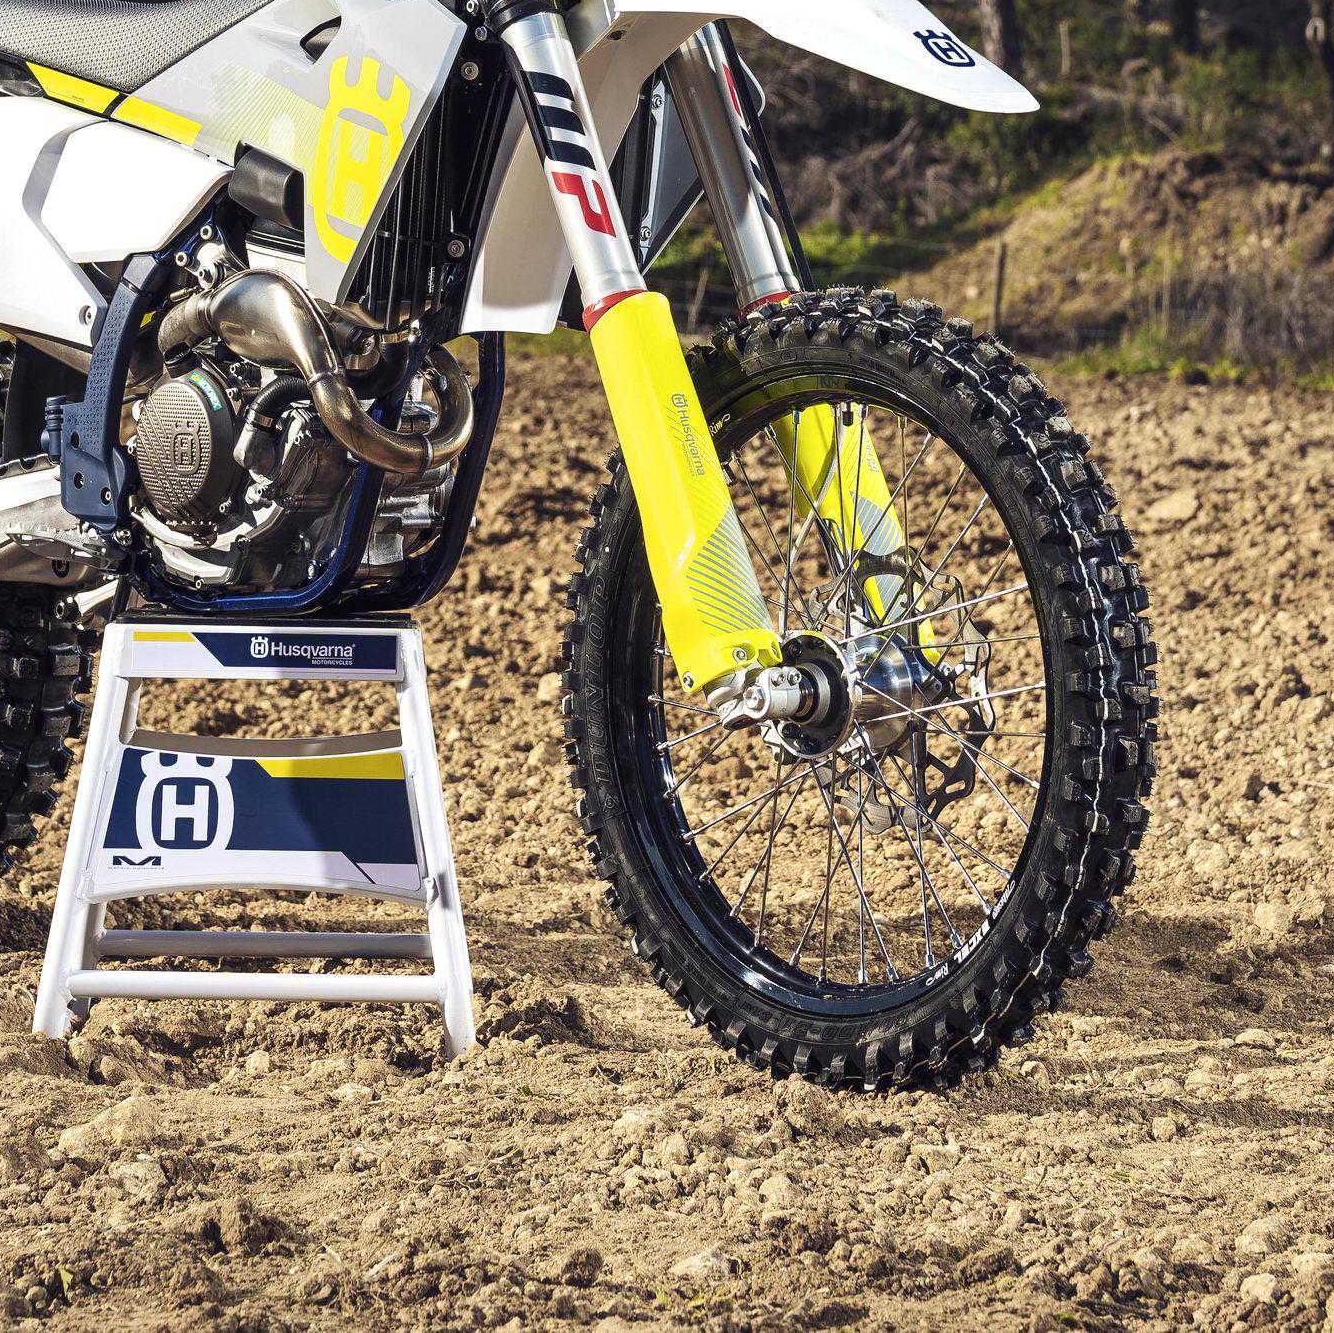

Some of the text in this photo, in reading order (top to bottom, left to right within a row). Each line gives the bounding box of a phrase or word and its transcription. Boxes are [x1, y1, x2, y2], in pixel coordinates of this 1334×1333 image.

[677, 409, 705, 475] Husqvarna
[271, 642, 353, 659] Husqvarna
[586, 576, 613, 785] DUNLOP
